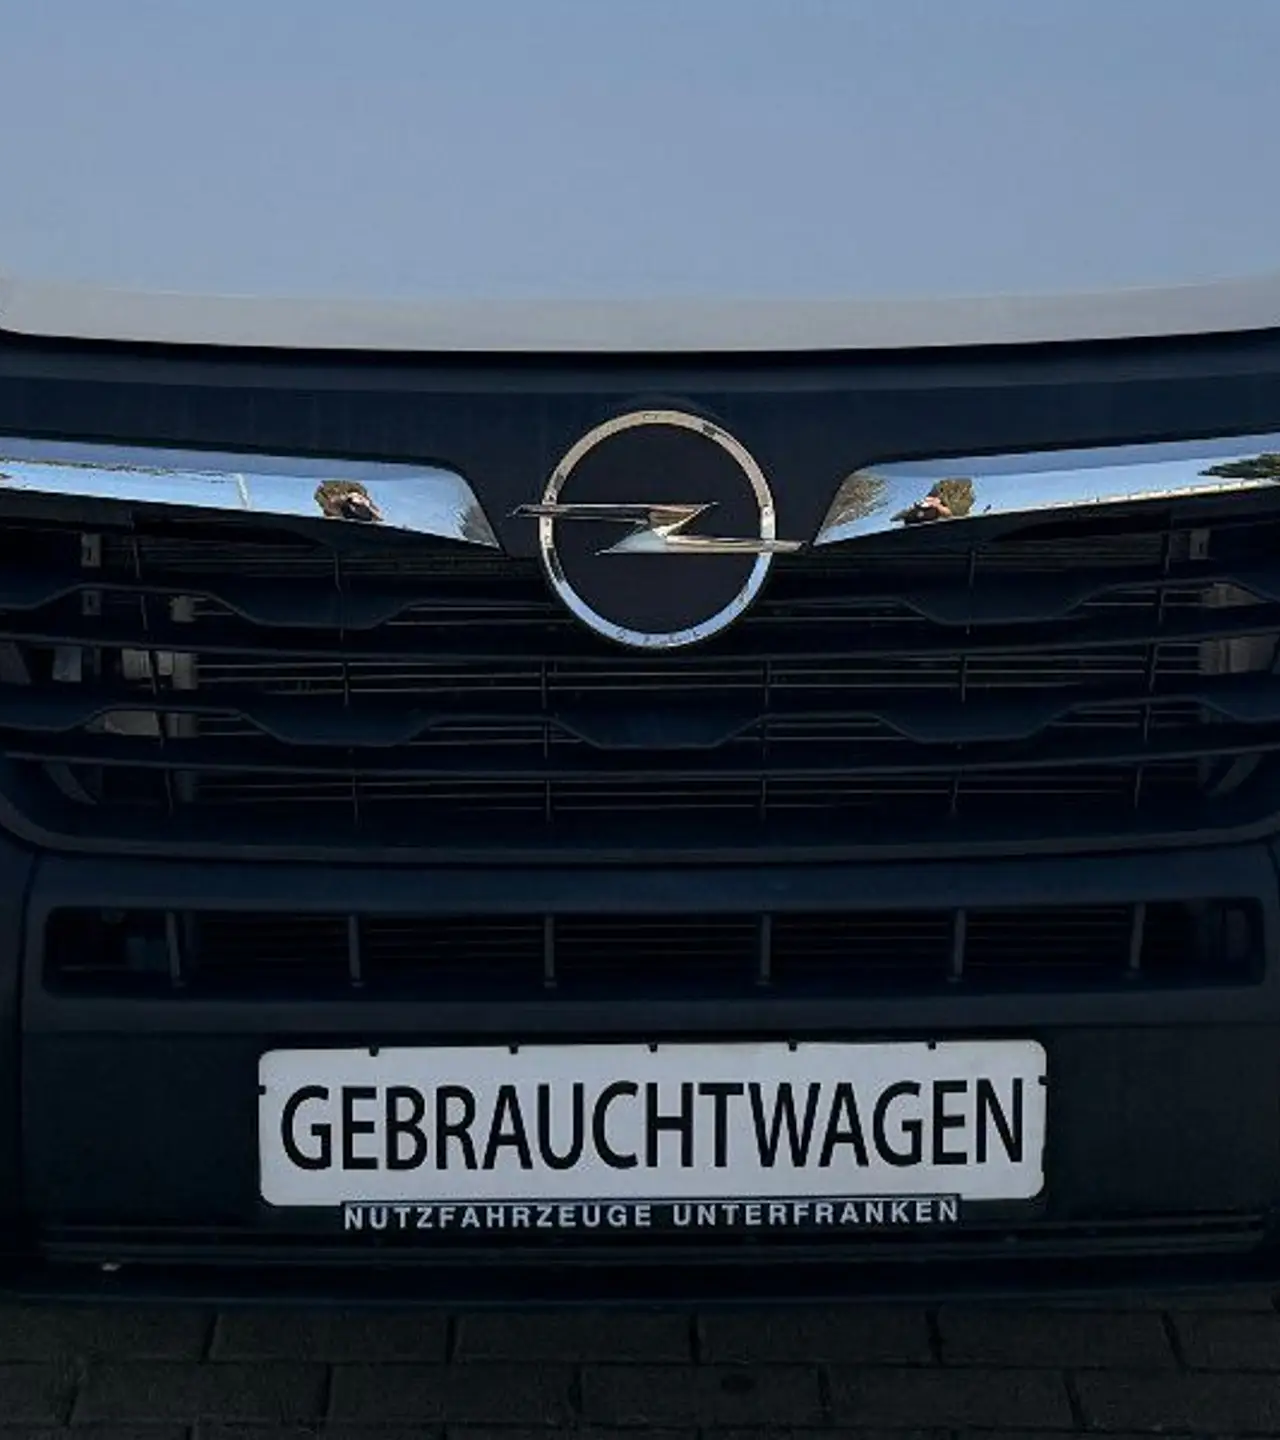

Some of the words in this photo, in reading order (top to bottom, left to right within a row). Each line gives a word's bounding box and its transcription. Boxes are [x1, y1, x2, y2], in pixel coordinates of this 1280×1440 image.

[281, 1078, 1023, 1169] GEBRAUCHTWAGEN
[344, 1204, 652, 1230] NUTZFAHRZEUGE
[673, 1200, 958, 1226] UNTERFRANKEN
